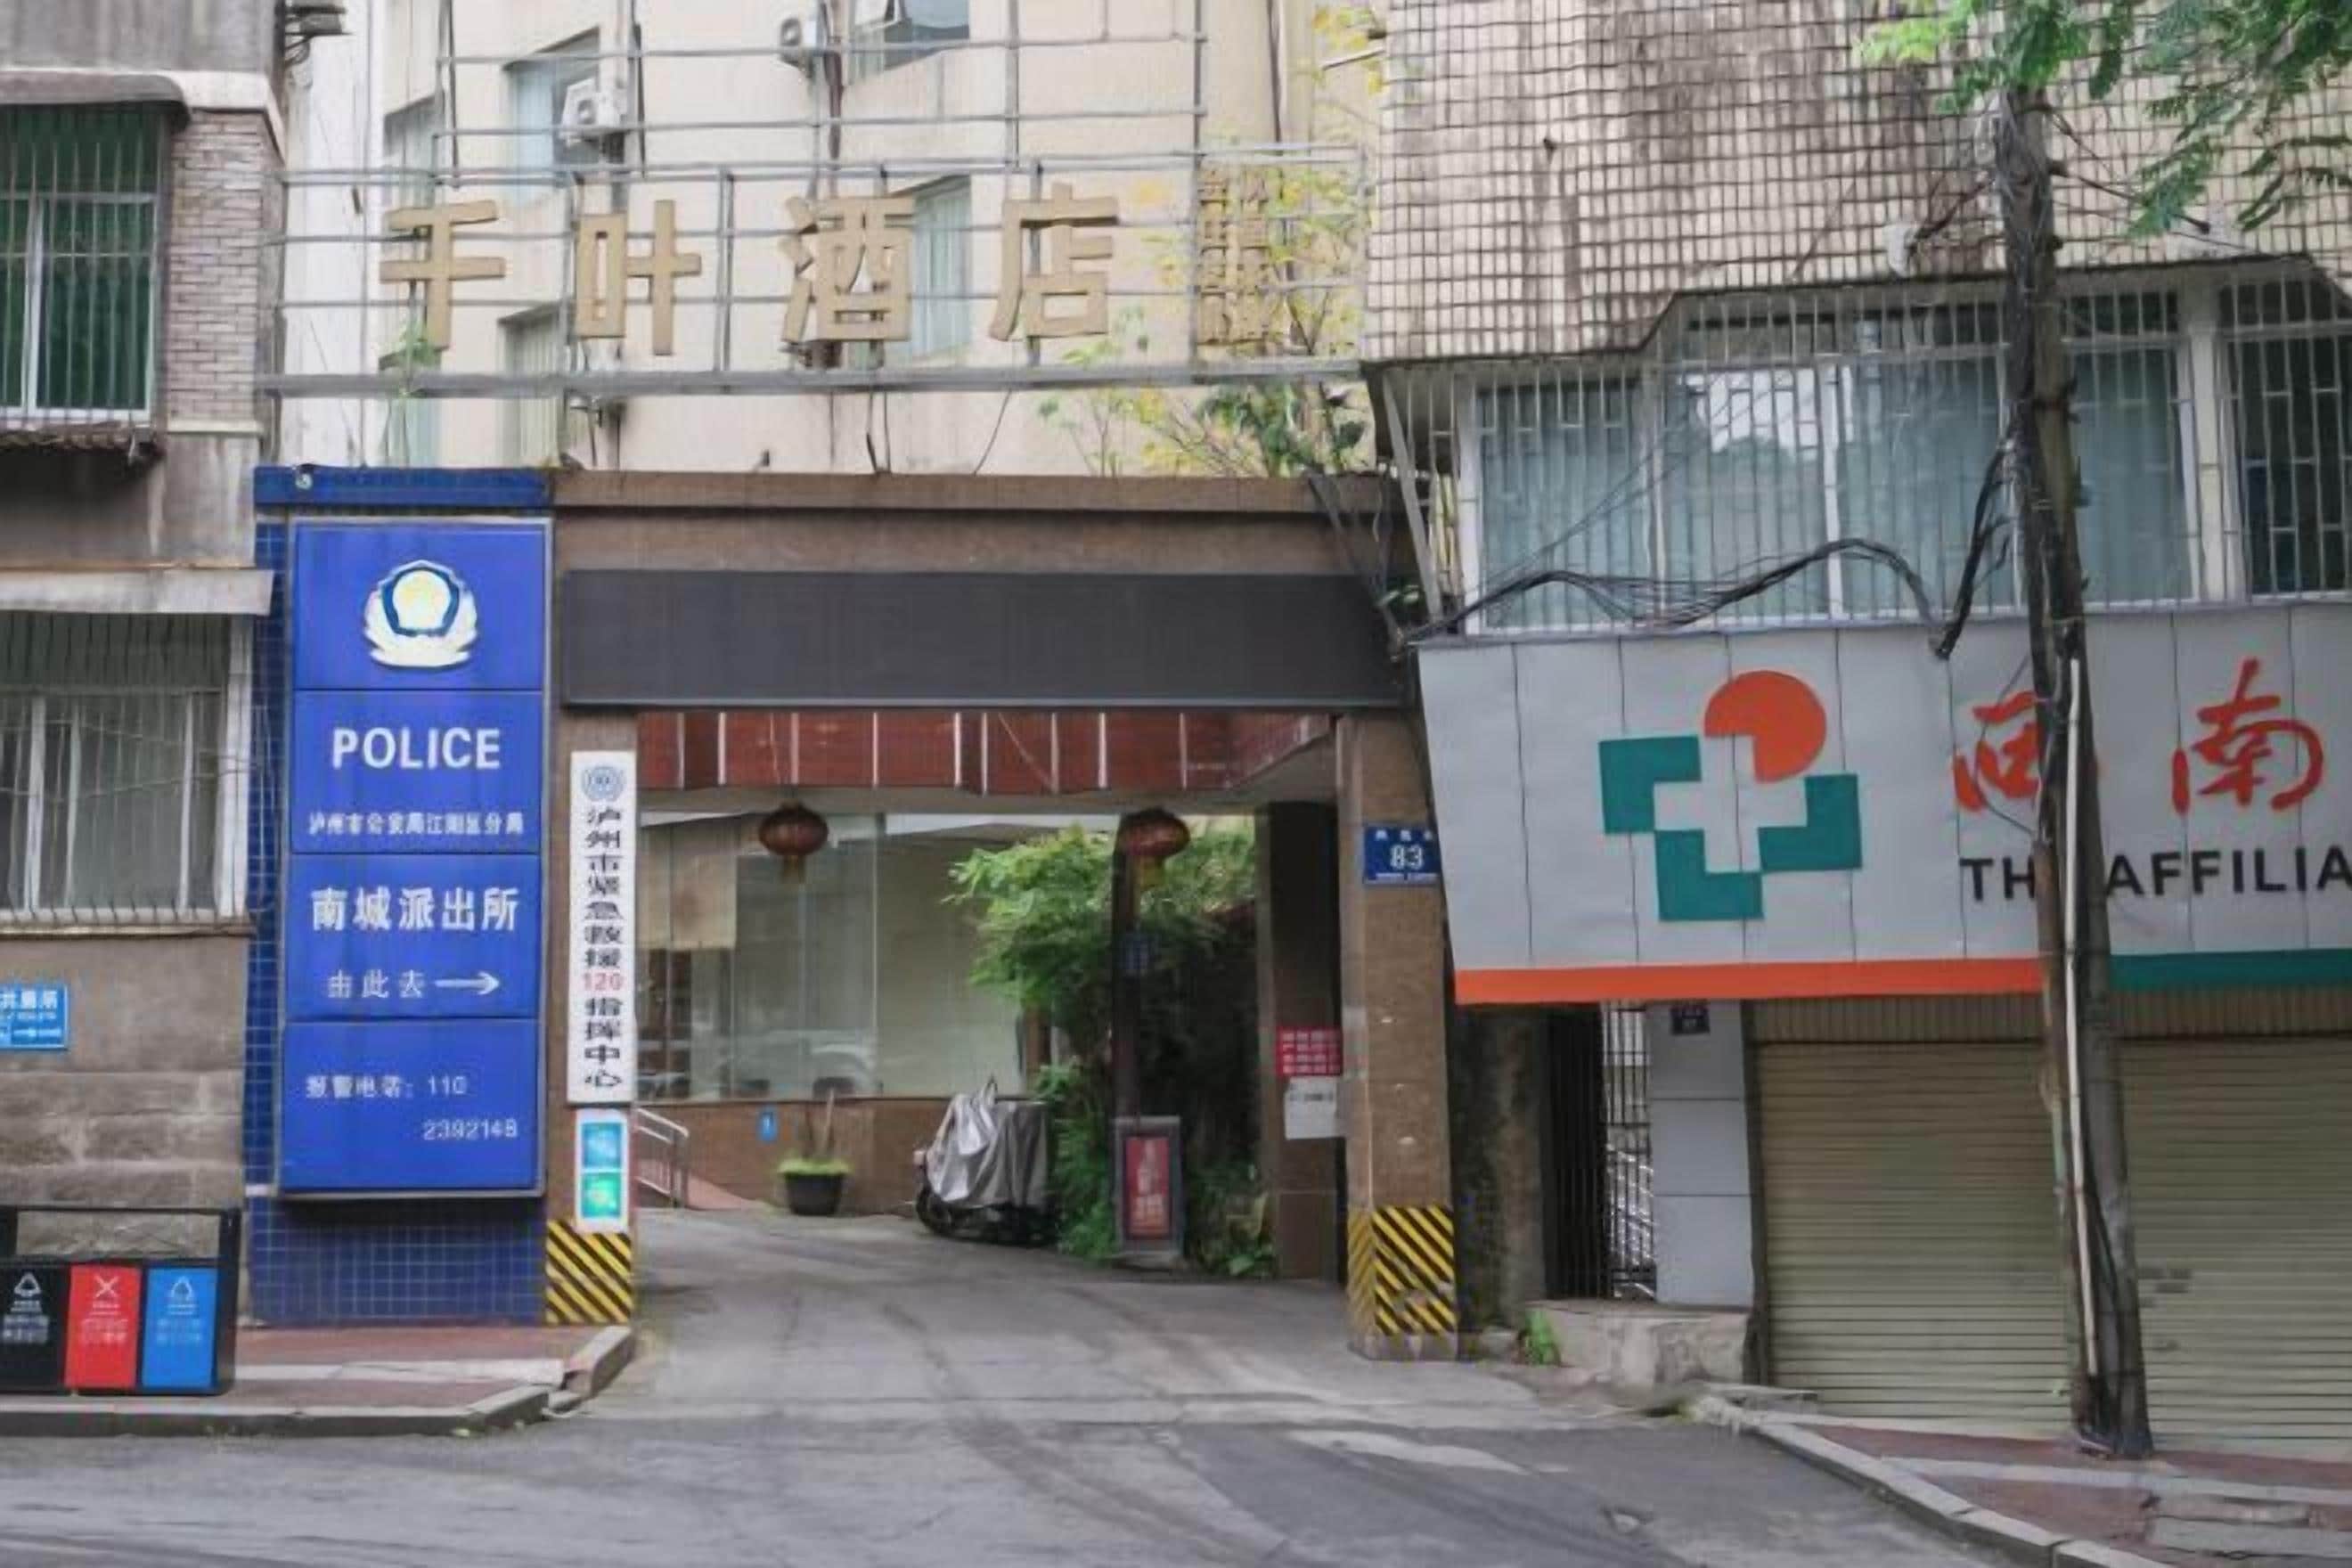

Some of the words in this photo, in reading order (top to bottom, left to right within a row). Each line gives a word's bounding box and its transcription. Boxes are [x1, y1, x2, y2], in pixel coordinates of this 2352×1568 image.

[380, 178, 1119, 355] 千叶酒店
[332, 726, 501, 770] POLICE
[1390, 844, 1424, 870] 83
[1960, 855, 2036, 901] TH
[311, 886, 519, 931] 南城派出所
[328, 968, 425, 999] 由此去
[428, 1075, 468, 1096] 110
